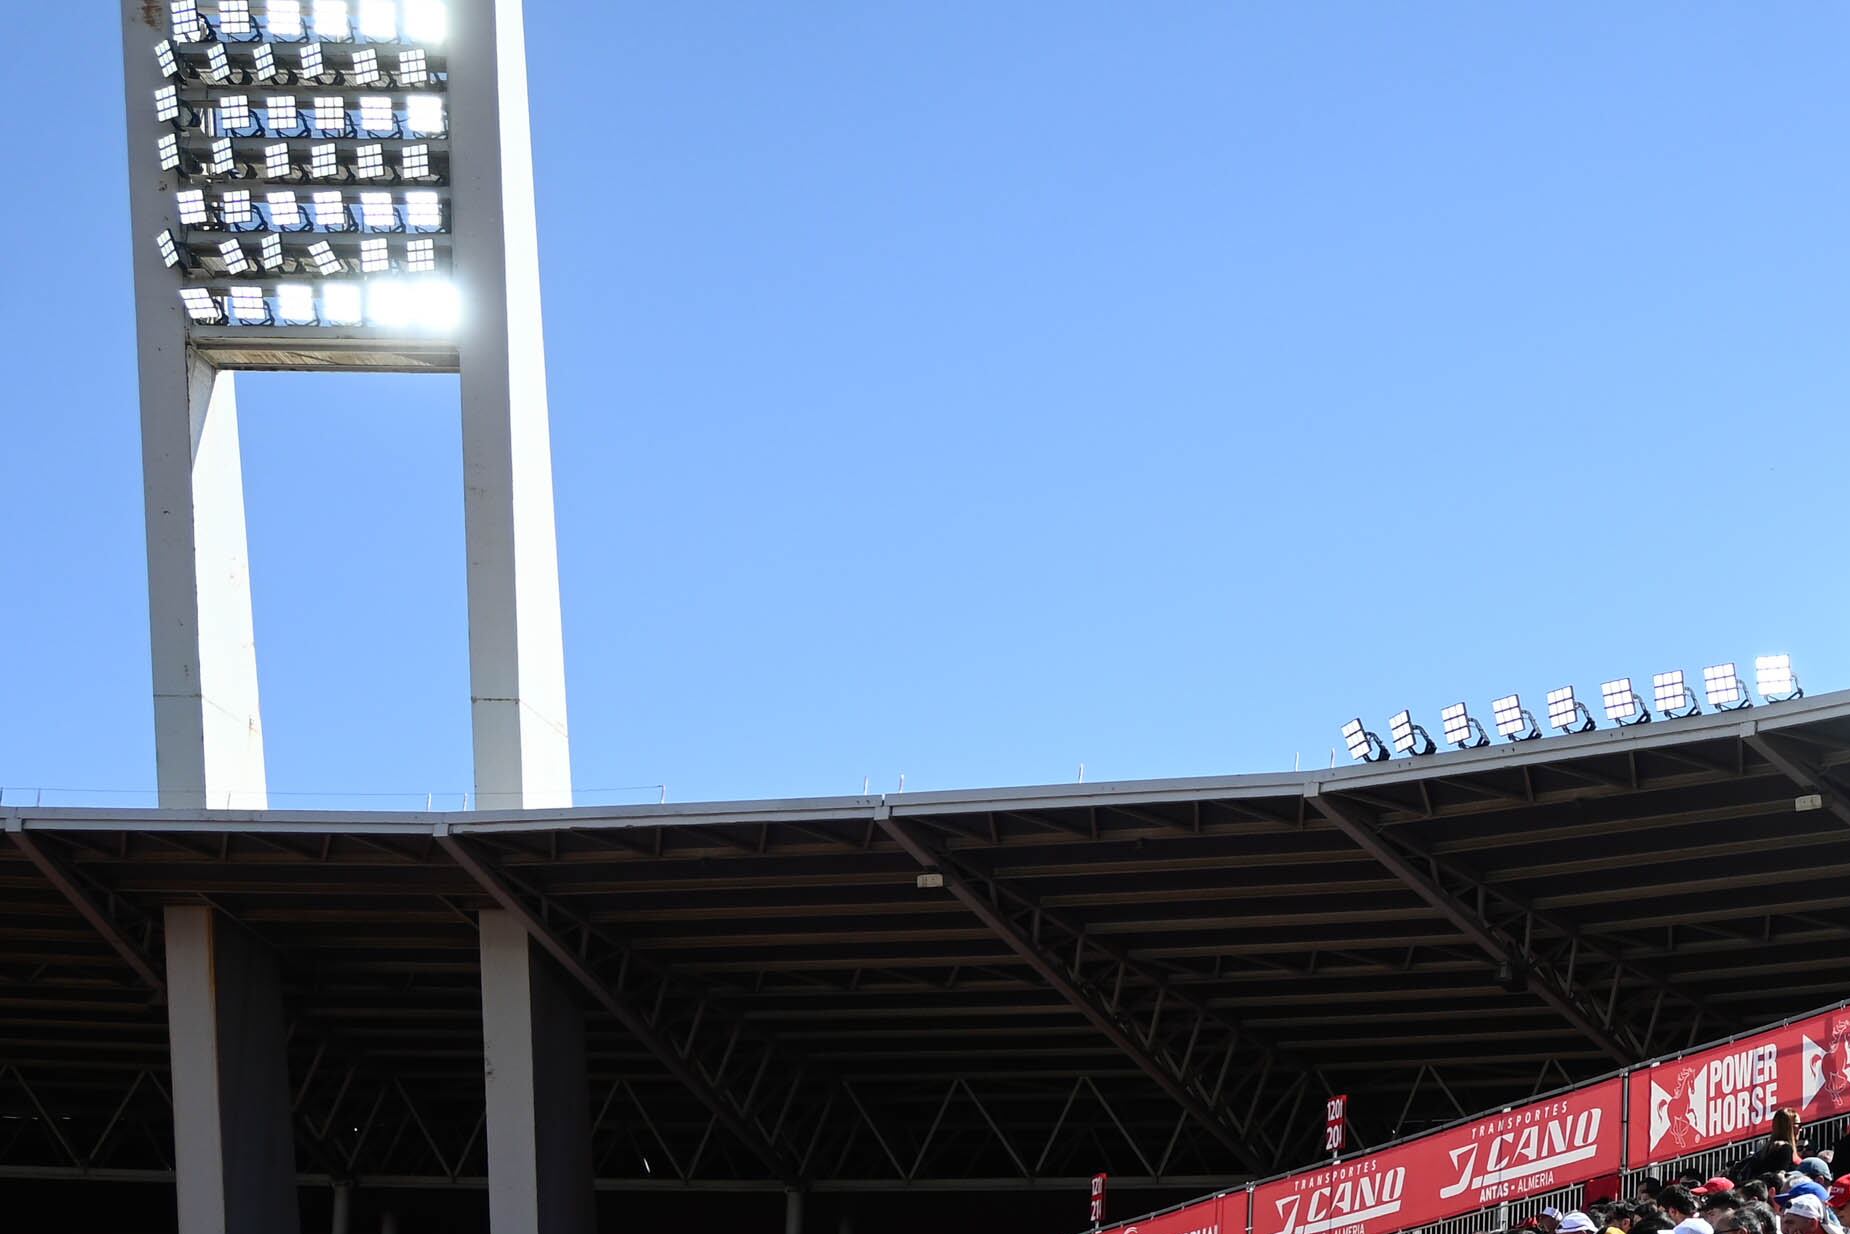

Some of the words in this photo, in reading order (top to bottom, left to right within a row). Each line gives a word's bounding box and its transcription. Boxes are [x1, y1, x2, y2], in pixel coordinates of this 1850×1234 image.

[1709, 1043, 1777, 1096] POWER
[1471, 1101, 1568, 1140] TRANSPORTES
[1708, 1082, 1777, 1137] HORSE
[1294, 1160, 1377, 1191] TRANSPORTES
[1480, 1183, 1509, 1203] ANTAS
[1518, 1172, 1554, 1194] ALMERIA
